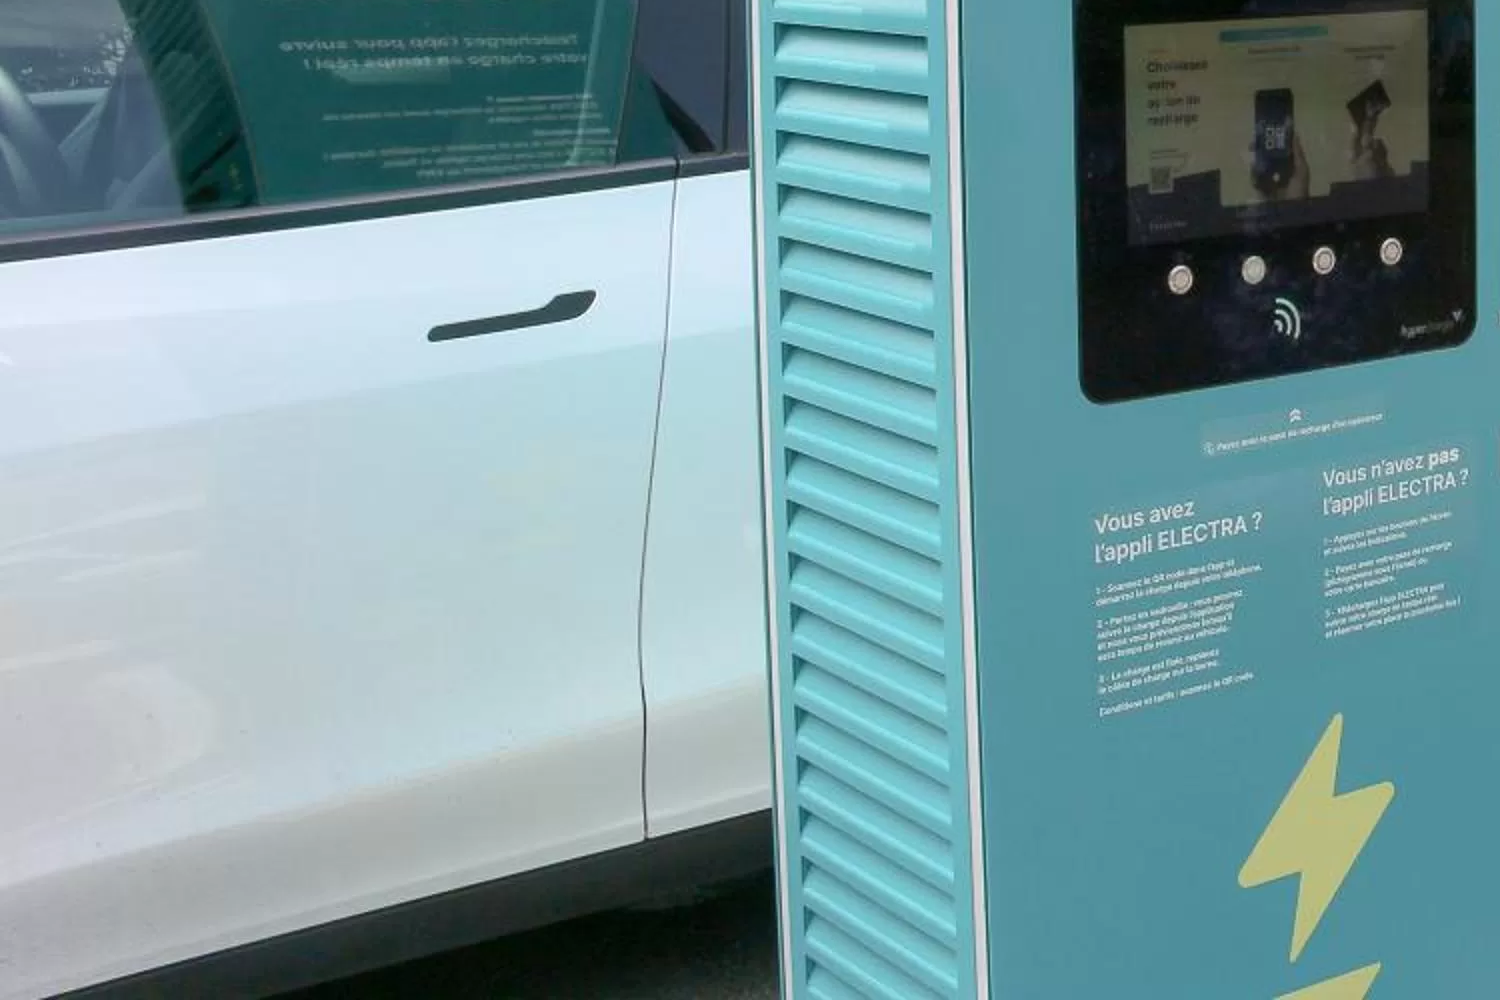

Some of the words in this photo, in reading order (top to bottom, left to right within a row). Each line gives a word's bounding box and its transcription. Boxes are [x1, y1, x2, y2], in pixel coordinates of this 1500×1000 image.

[1323, 467, 1367, 488] Vous
[1371, 455, 1424, 479] n'avez
[1428, 448, 1460, 470] pas
[1323, 487, 1374, 516] l'appli
[1378, 471, 1456, 504] ELECTRA
[1459, 468, 1470, 485] ?
[1095, 512, 1135, 534] Vous
[1150, 502, 1195, 523] avez
[1095, 533, 1153, 564] l'appli
[1158, 515, 1248, 551] ELECTRA
[1251, 512, 1262, 530] ?
